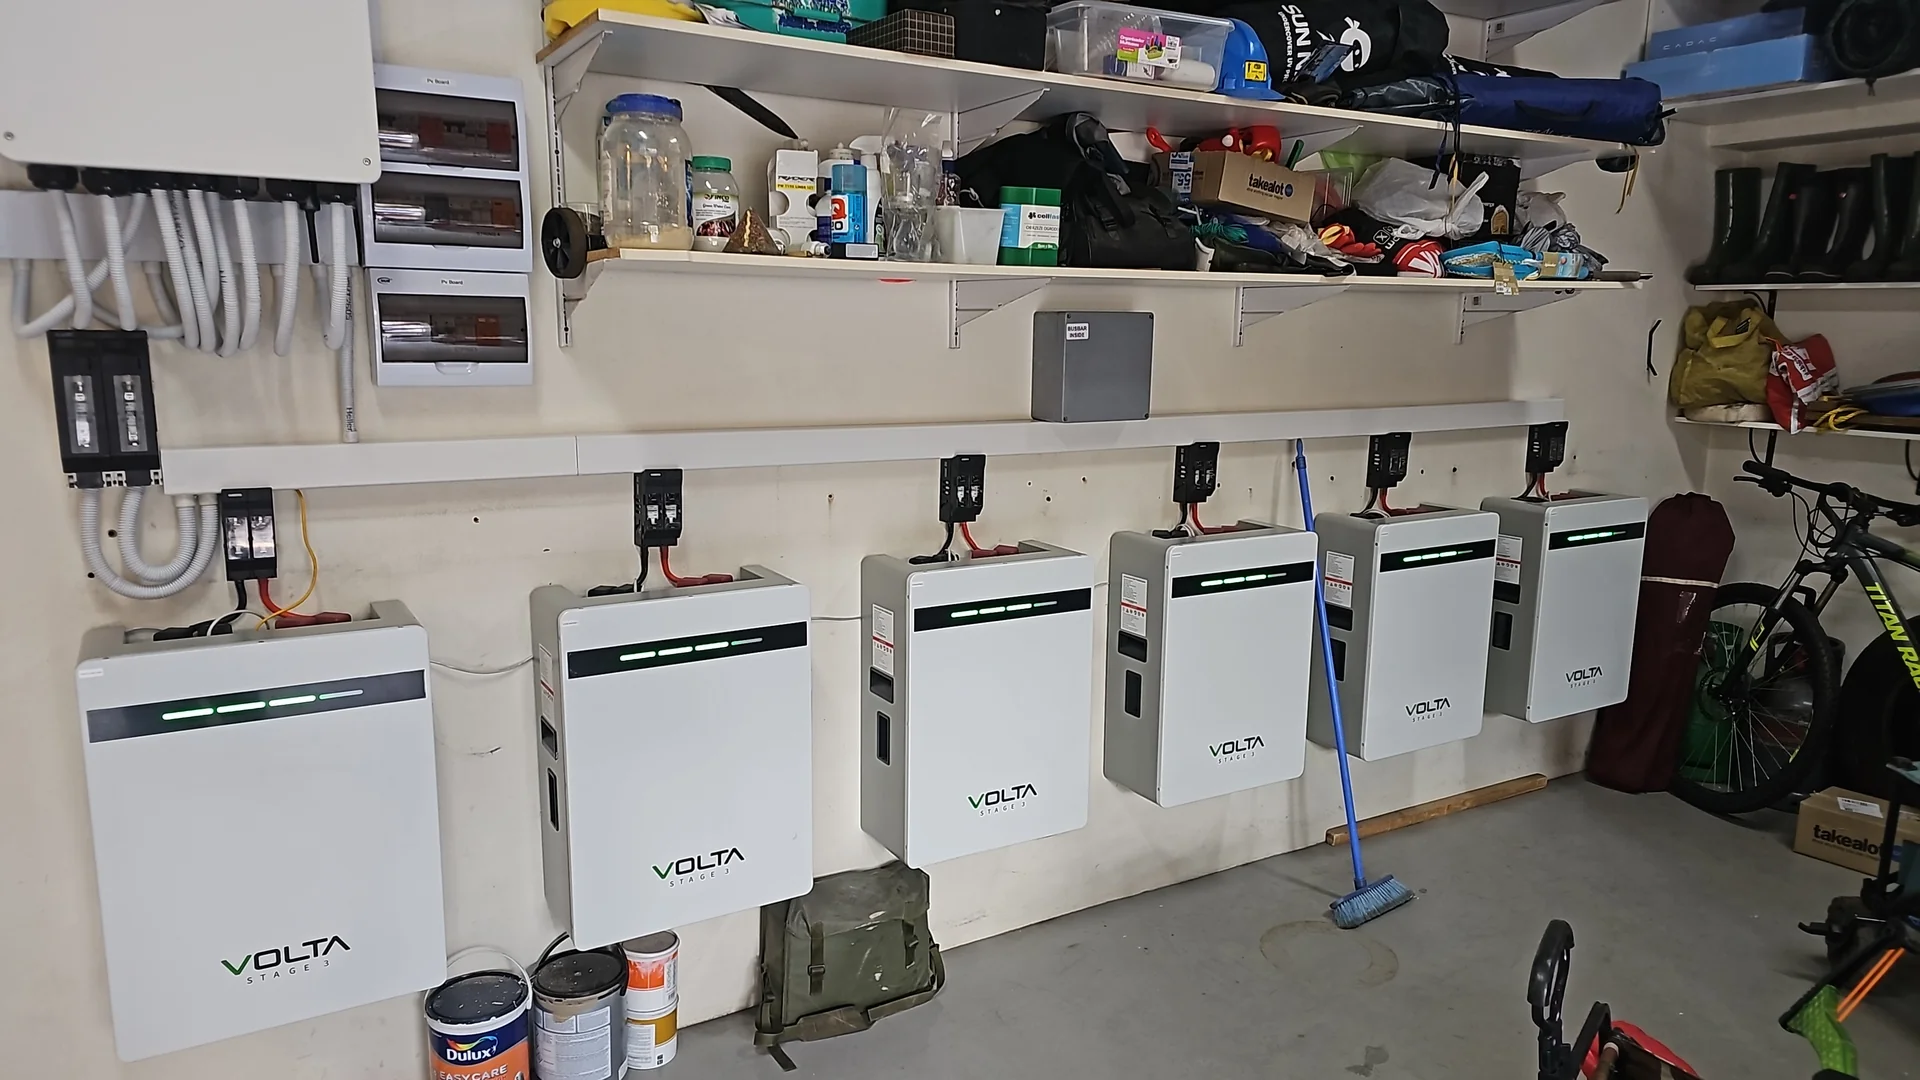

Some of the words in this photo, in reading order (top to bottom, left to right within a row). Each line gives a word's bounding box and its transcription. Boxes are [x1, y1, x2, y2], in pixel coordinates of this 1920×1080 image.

[1281, 4, 1311, 47] SUN
[1663, 36, 1717, 51] CADAC
[1249, 173, 1285, 196] takealot
[1865, 582, 1910, 642] TITAN
[1566, 666, 1603, 683] VOLTA
[1405, 697, 1451, 716] VOLTA
[1209, 735, 1265, 757] VOLTA
[1218, 753, 1246, 764] STAGE
[967, 783, 1038, 809] VOLTA
[980, 803, 1015, 817] STAGE
[651, 847, 745, 880] VOLTA
[669, 871, 715, 888] STAGE
[220, 935, 351, 976] VOLTA
[246, 964, 310, 985] STAGE
[323, 959, 330, 967] 3
[446, 1048, 492, 1061] Dulux
